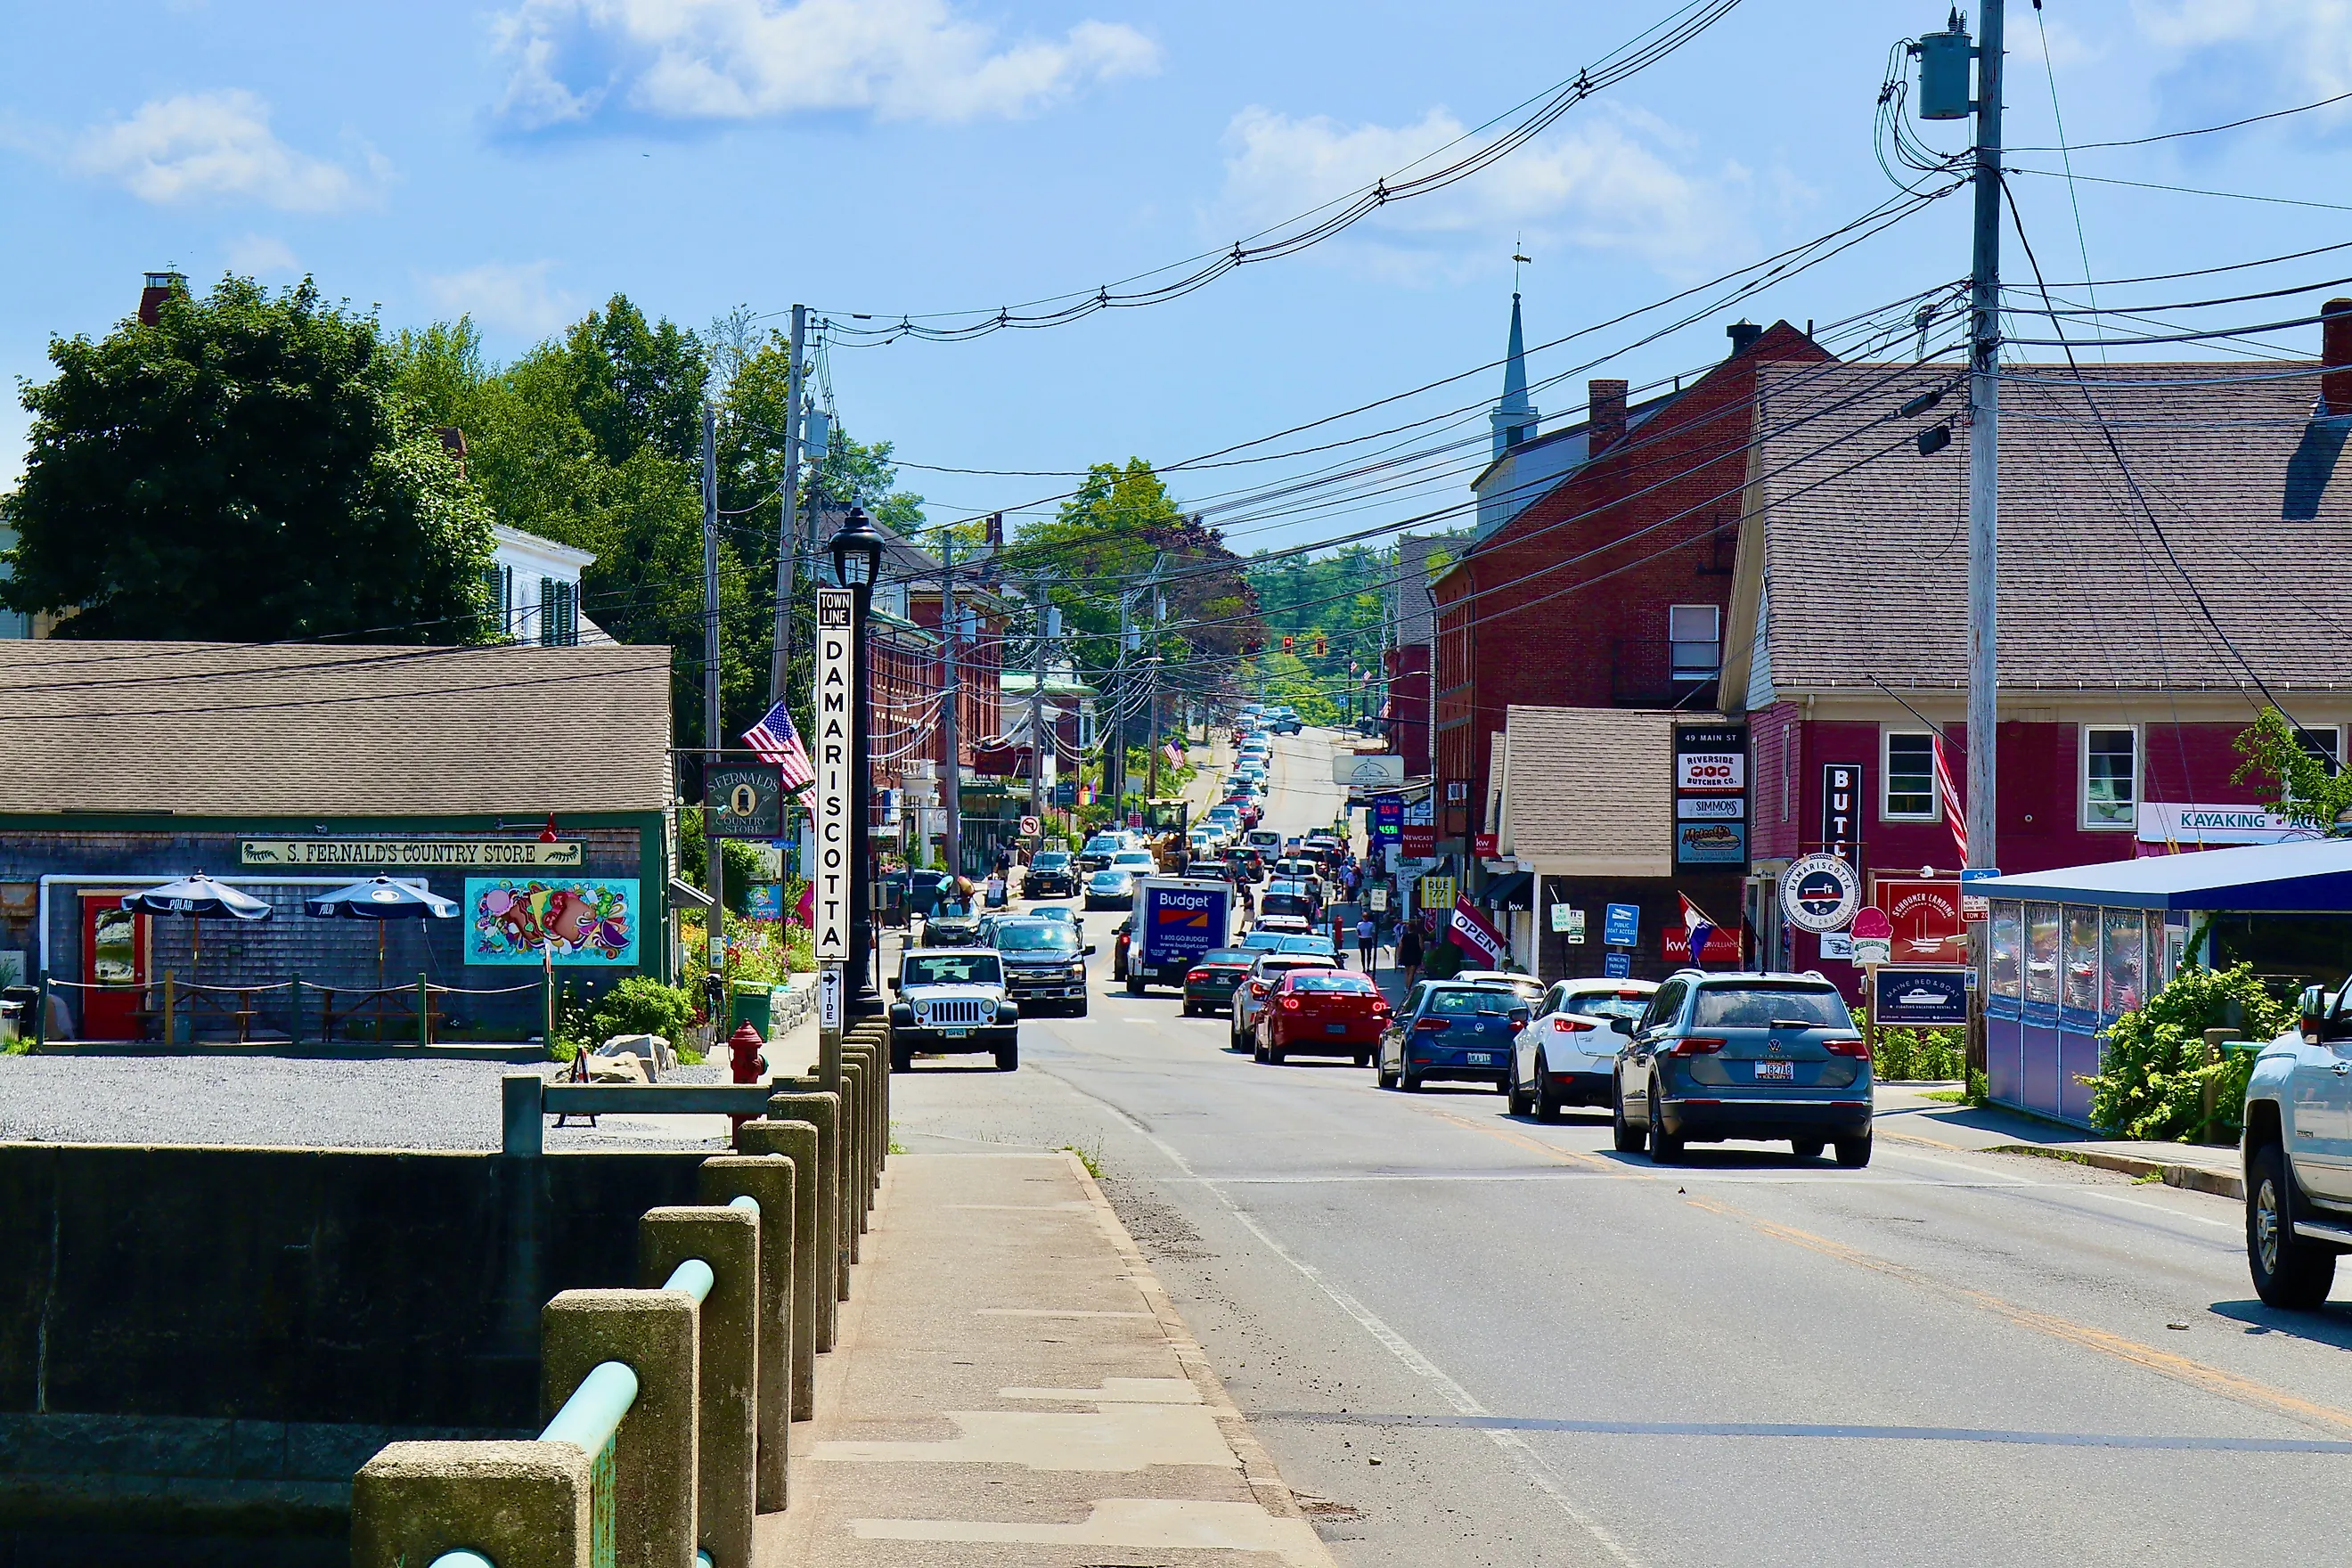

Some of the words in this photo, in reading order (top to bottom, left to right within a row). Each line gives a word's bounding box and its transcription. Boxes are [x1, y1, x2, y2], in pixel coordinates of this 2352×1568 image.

[821, 594, 849, 608] TOWN
[822, 609, 846, 624] LINE
[1686, 755, 1734, 764] RIVERSIDE
[1686, 777, 1722, 786] BUTCHER
[1723, 777, 1737, 785] CO.
[821, 641, 845, 946] DAMARISCOTTA
[1695, 801, 1737, 816] SIMMONS
[715, 816, 769, 827] COUNTRY
[2181, 813, 2266, 828] KAYAKING
[724, 825, 763, 834] STORE
[1476, 837, 1489, 847] kw
[287, 844, 300, 862] S.
[306, 843, 398, 863] FERNALD'S
[403, 843, 480, 863] COUNTRY
[484, 844, 535, 863] STORE
[1789, 862, 1851, 890] DAMARISCOTTA
[1427, 881, 1449, 889] RUE
[168, 898, 193, 911] POLAR
[1159, 893, 1209, 910] Budget
[1508, 900, 1524, 911] kw
[1891, 893, 1926, 917] SCHOONER
[1928, 893, 1956, 918] LANDING
[1793, 904, 1814, 924] RIVER
[1818, 902, 1850, 926] CRUISES
[1455, 916, 1497, 953] OPEN
[1666, 936, 1686, 951] kw
[1886, 980, 1911, 999] MAINE
[826, 987, 834, 1020] TIDE
